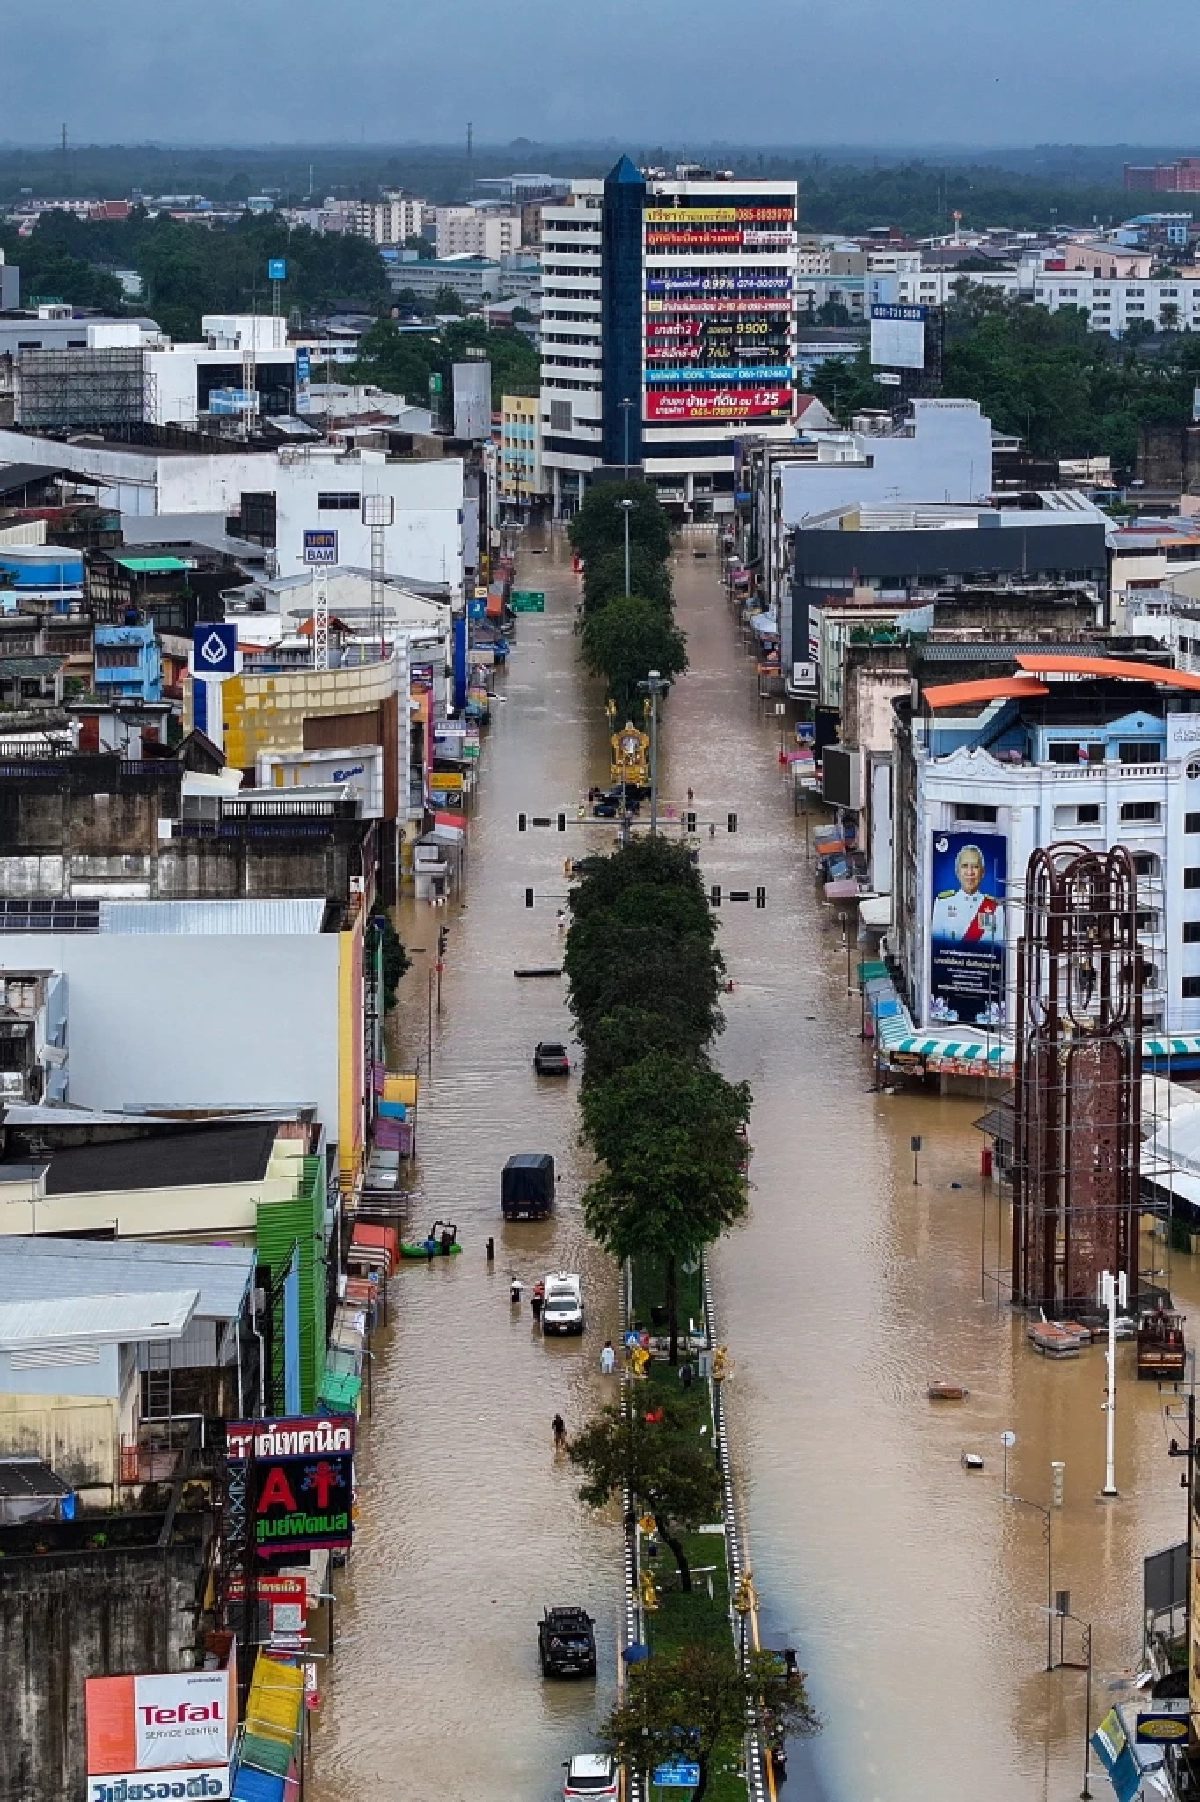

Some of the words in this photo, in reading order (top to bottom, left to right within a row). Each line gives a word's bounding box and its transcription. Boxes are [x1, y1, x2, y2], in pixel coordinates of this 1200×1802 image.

[307, 548, 334, 561] BAM
[138, 1701, 224, 1726] Tefal
[145, 1729, 182, 1740] SERVICE
[184, 1726, 220, 1737] CENTER
